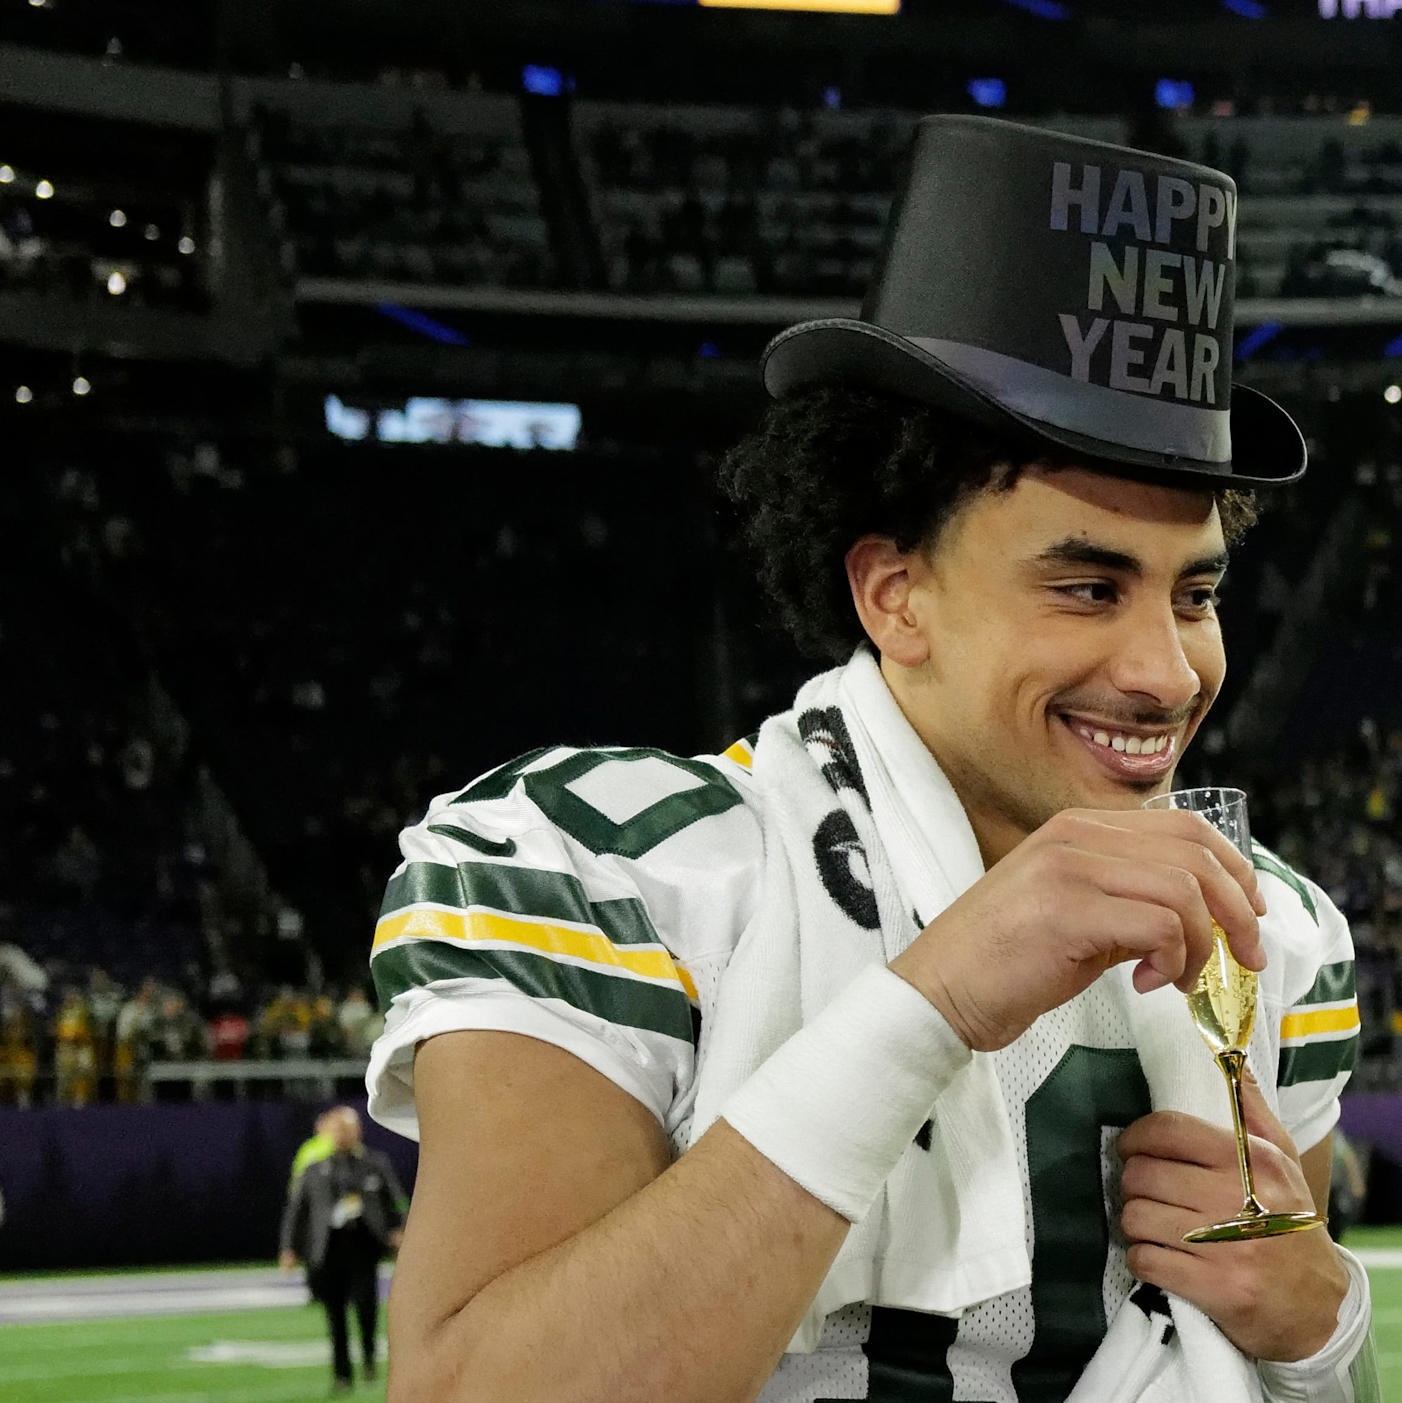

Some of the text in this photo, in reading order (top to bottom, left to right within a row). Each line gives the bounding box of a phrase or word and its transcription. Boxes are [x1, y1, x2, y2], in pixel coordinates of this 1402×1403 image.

[1050, 162, 1238, 260] HAPPY
[1088, 241, 1226, 330] NEW
[1058, 313, 1220, 404] YEAR
